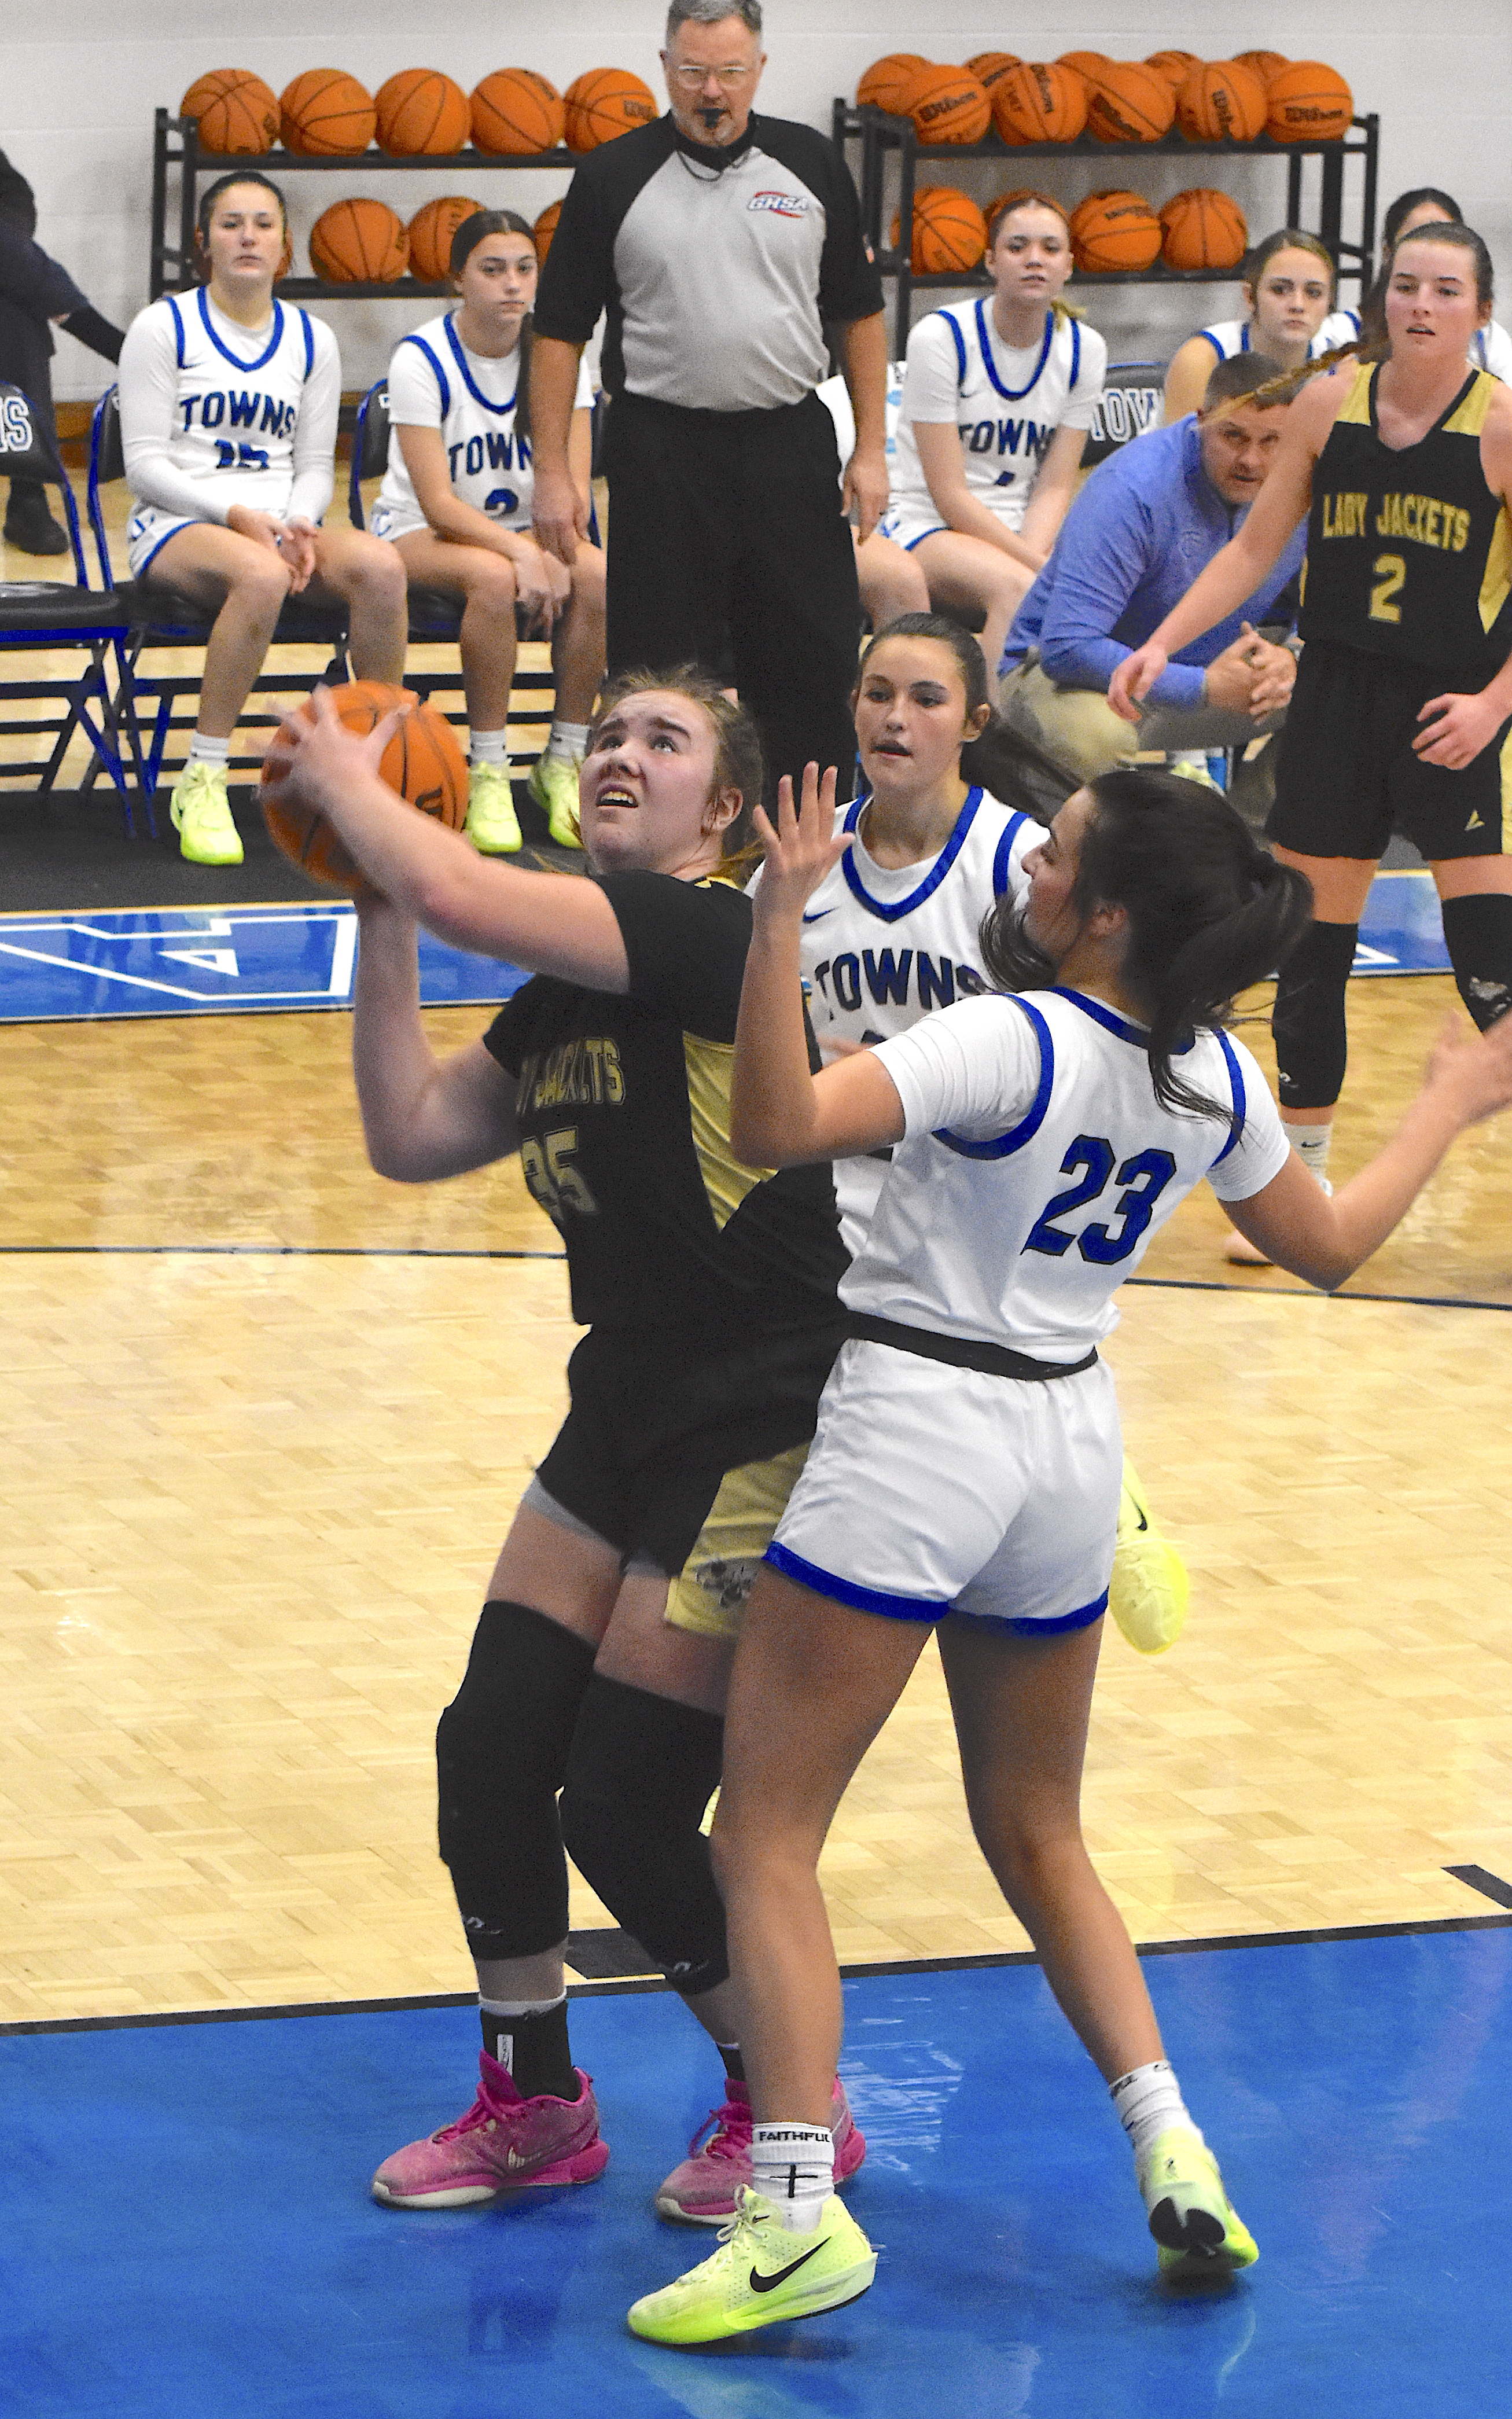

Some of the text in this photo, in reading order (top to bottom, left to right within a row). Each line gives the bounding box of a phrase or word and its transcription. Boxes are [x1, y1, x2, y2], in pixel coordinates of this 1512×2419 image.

[747, 196, 809, 211] GHSA
[179, 389, 296, 439] TOWNS
[448, 432, 532, 482] TOWN
[1322, 492, 1471, 552] LADY JACKETS
[1367, 553, 1407, 624] 2
[1020, 1134, 1177, 1266] 23
[759, 2131, 830, 2142] FAITHFUL
